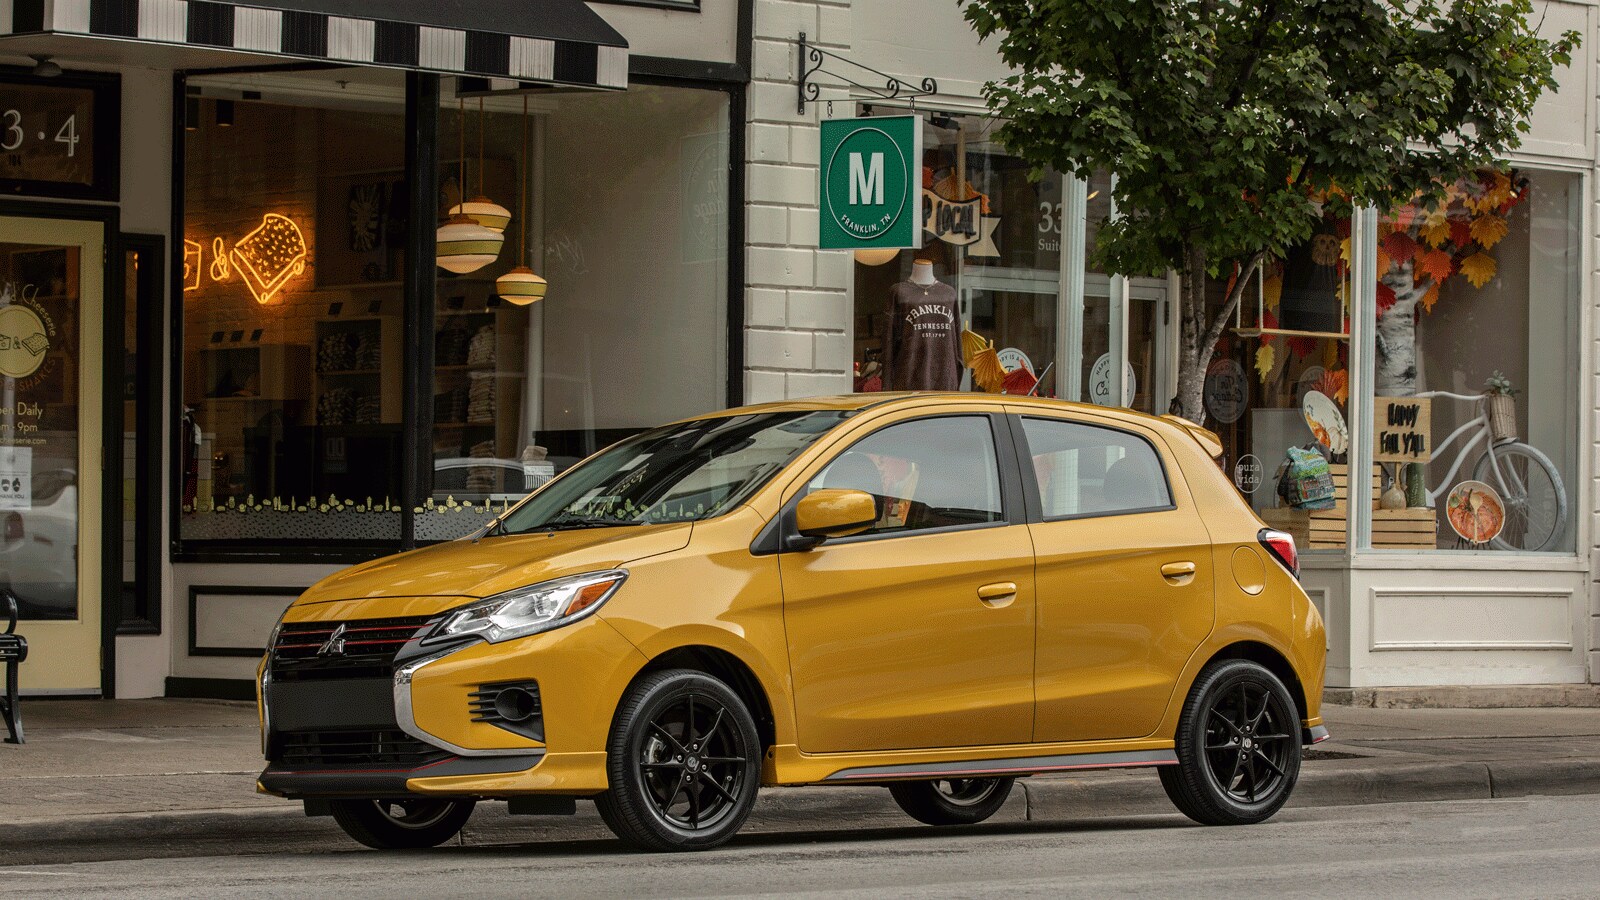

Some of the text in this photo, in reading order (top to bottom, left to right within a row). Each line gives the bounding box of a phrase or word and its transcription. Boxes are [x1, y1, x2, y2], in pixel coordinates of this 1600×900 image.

[848, 152, 884, 205] M
[841, 213, 891, 233] FRANKLIN, TN
[1038, 239, 1062, 252] Suit
[905, 304, 954, 324] FRANKLIN
[17, 401, 43, 419] Daily
[17, 421, 38, 435] 9pm
[1238, 463, 1260, 473] pura
[1238, 473, 1260, 484] vida
